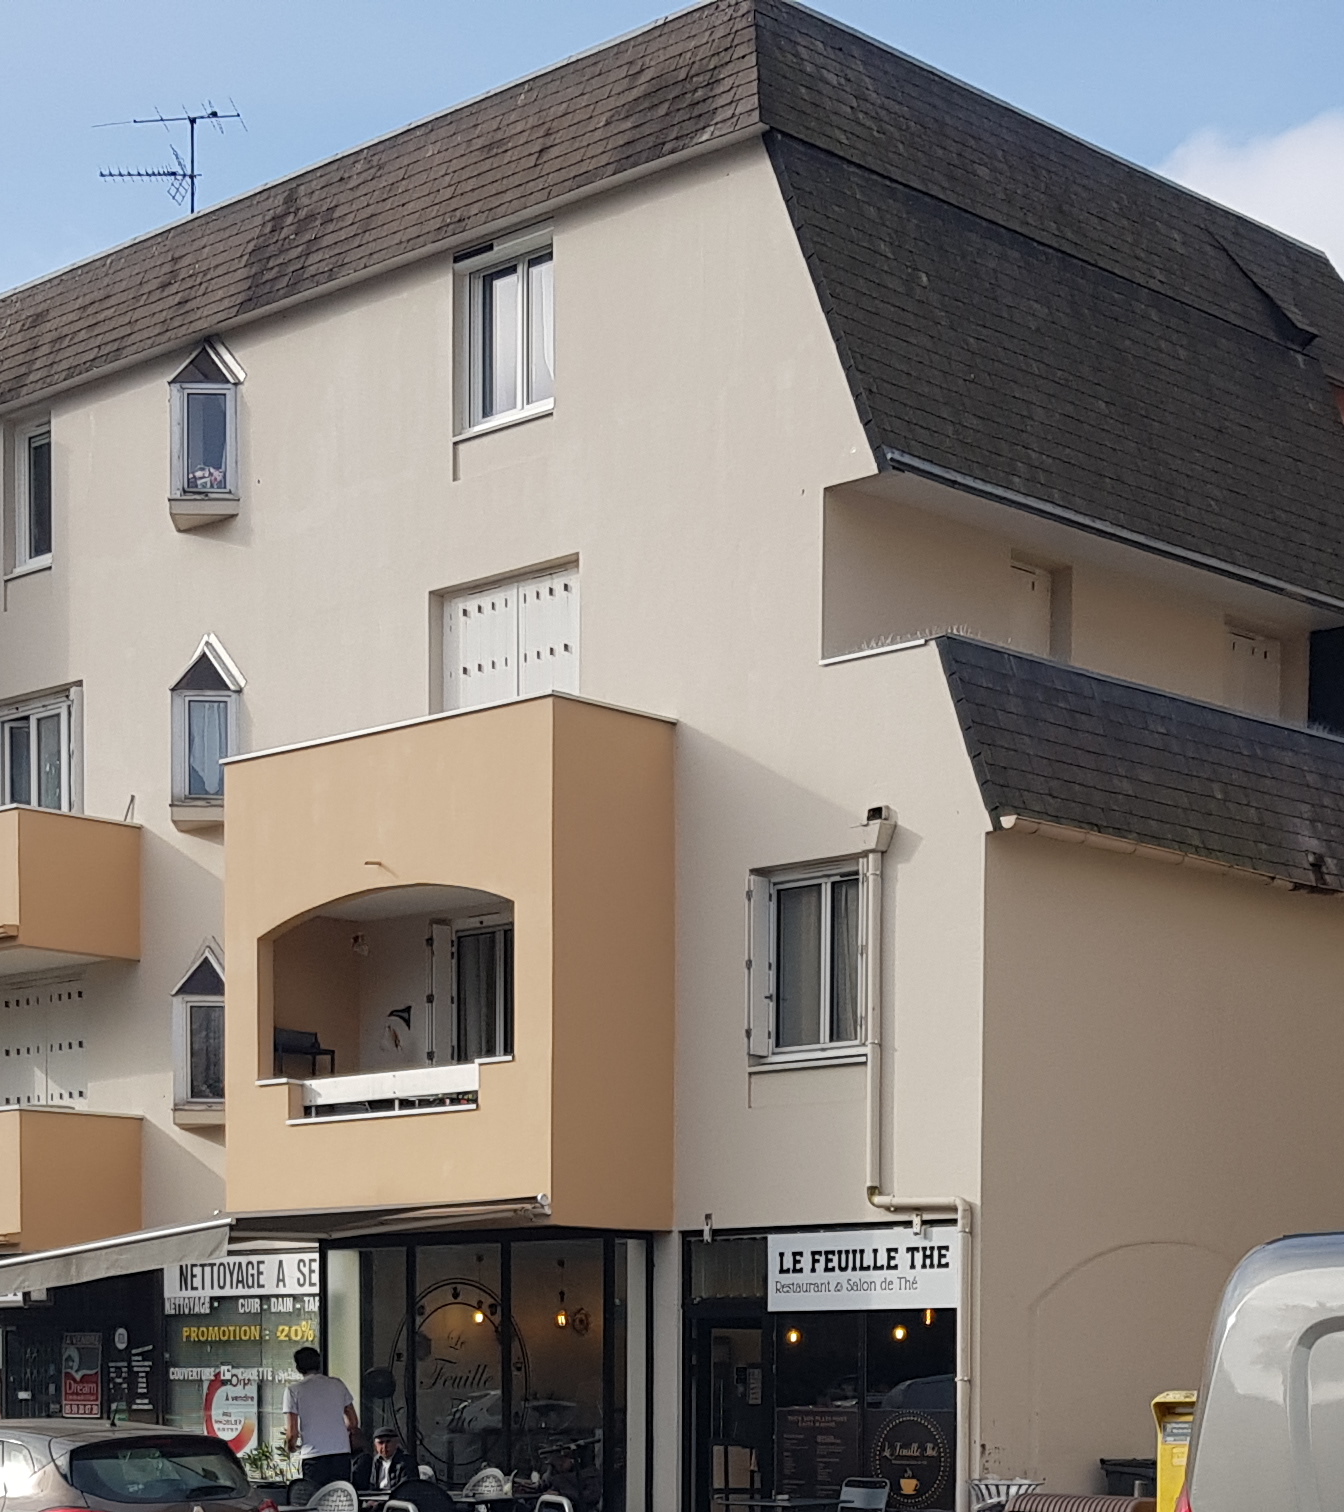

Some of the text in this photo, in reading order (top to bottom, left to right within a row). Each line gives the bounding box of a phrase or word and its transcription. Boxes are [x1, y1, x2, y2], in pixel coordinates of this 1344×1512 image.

[778, 1245, 950, 1274] LE FEUILLE THE
[179, 1260, 265, 1291] NETTOYAGE
[276, 1259, 286, 1288] A
[775, 1280, 831, 1294] Restaurant
[846, 1278, 877, 1292] Salon
[880, 1277, 894, 1291] de
[897, 1276, 918, 1290] Thé
[164, 1296, 210, 1315] NETTOYAGE
[238, 1298, 260, 1314] CUIR
[182, 1325, 261, 1342] PROMOTION
[66, 1379, 97, 1394] Dream
